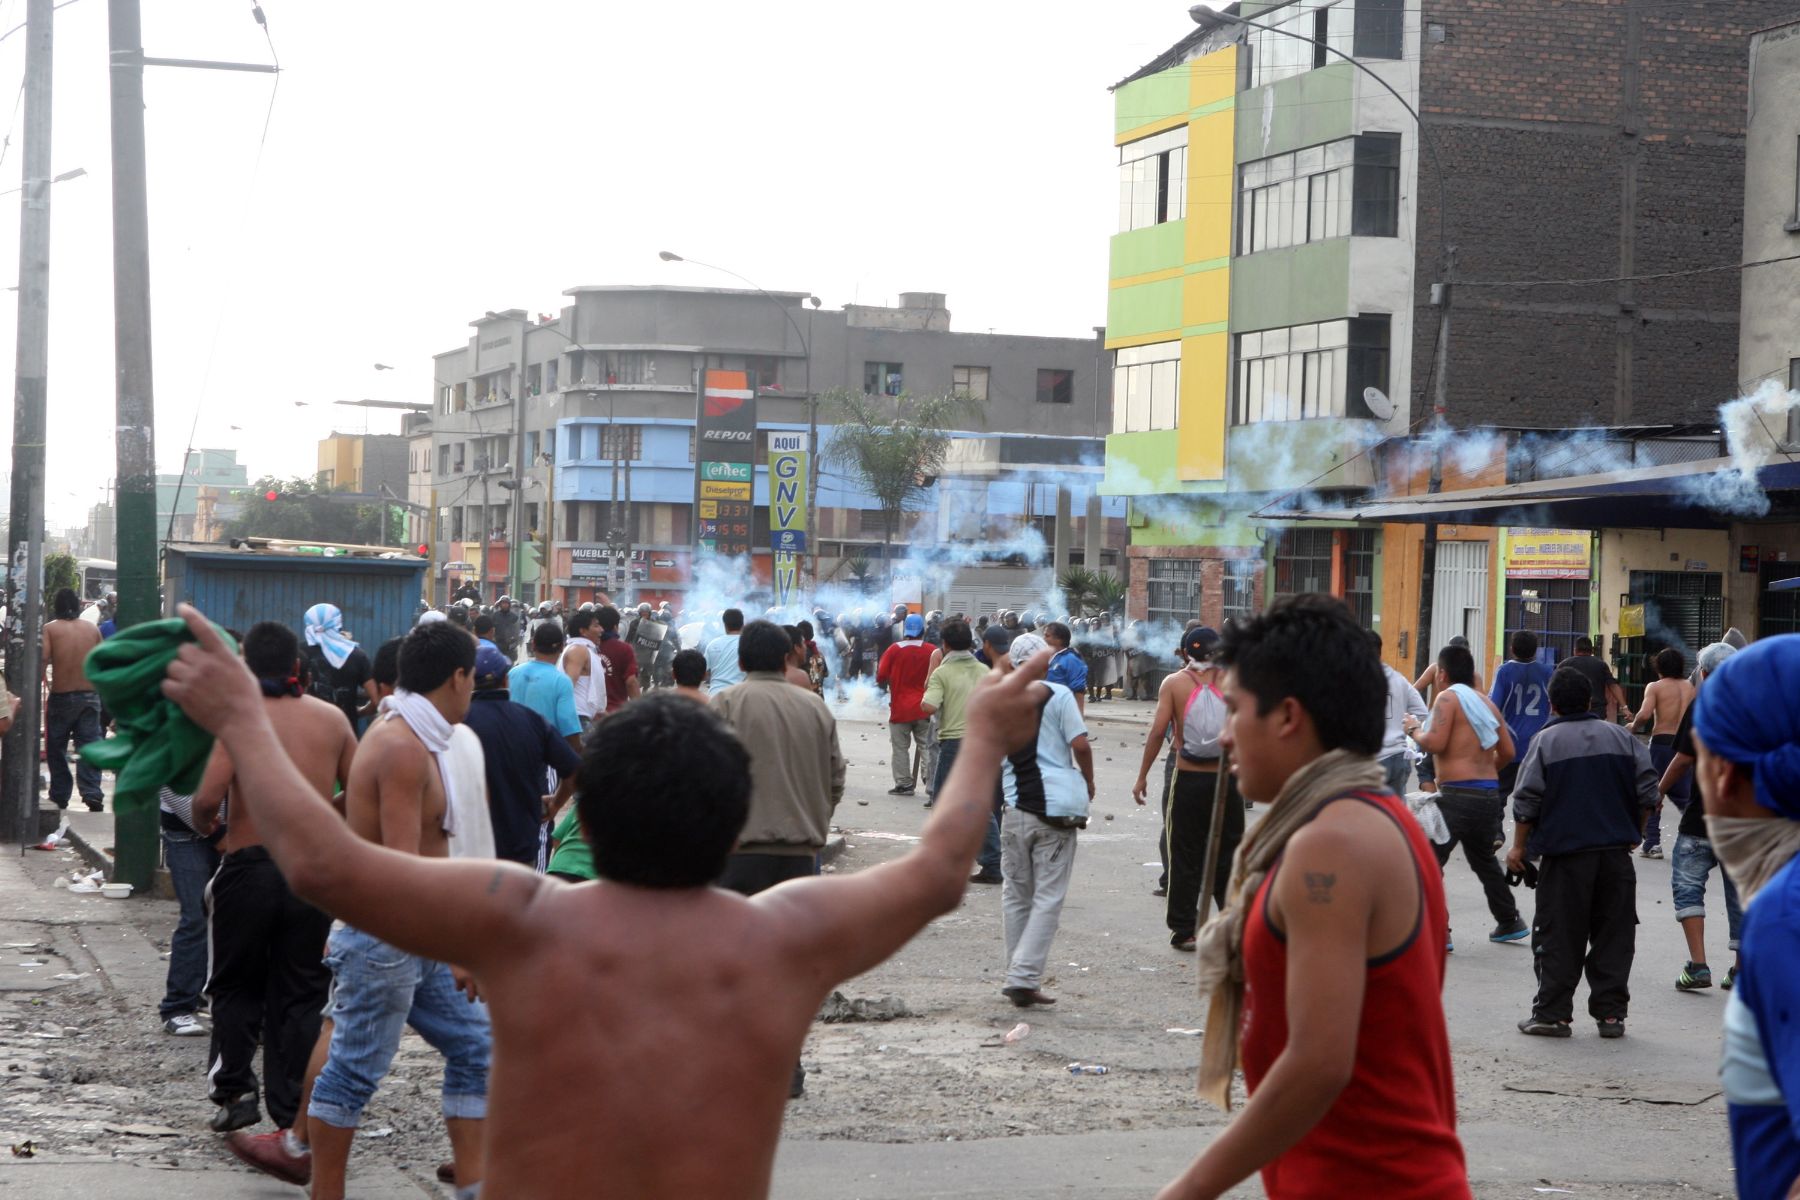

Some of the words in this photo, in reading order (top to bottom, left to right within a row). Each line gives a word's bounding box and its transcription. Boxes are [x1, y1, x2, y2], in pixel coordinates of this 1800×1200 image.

[704, 430, 752, 441] REPSOL
[711, 464, 747, 477] efitec
[1514, 683, 1541, 716] 12
